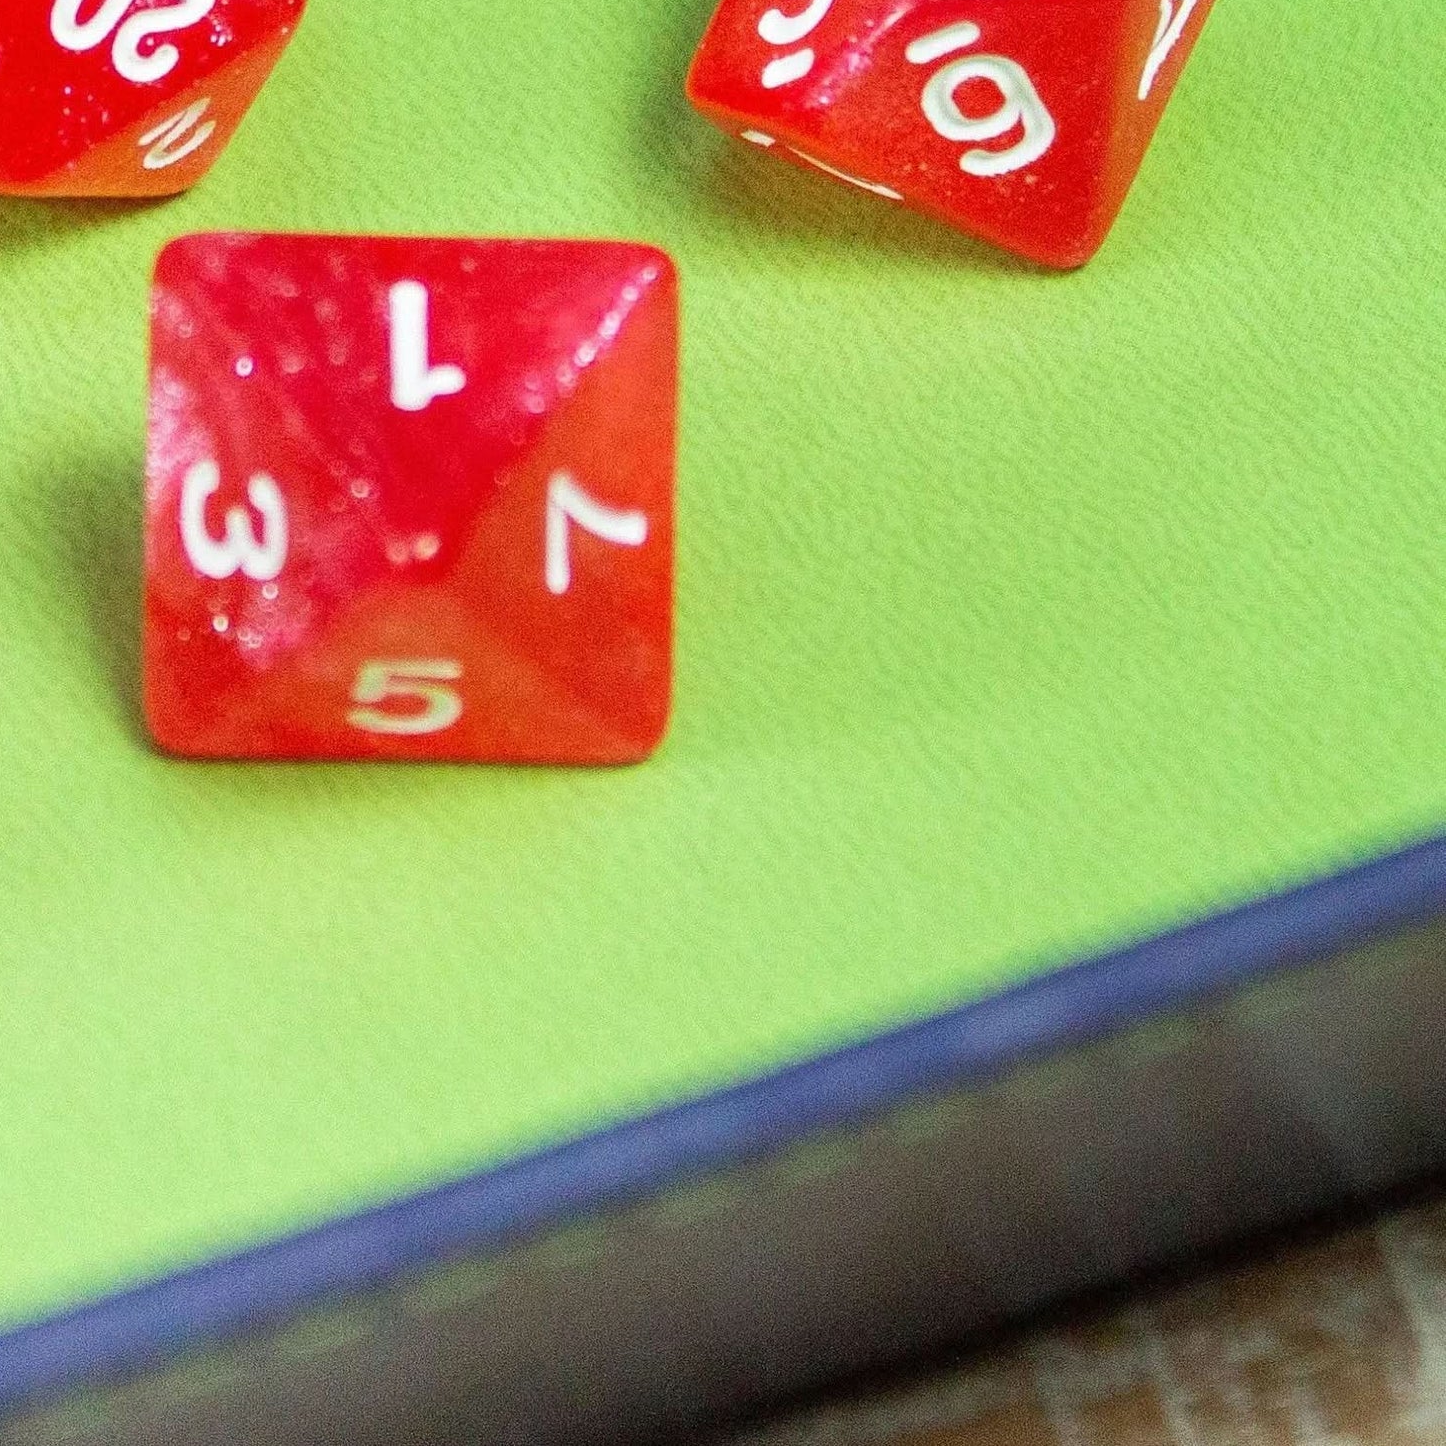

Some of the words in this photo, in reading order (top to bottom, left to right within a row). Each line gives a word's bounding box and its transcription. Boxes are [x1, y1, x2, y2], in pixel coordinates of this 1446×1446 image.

[388, 280, 467, 411] 1
[180, 459, 288, 581] 3
[545, 471, 648, 594] 7
[346, 659, 463, 735] 5
